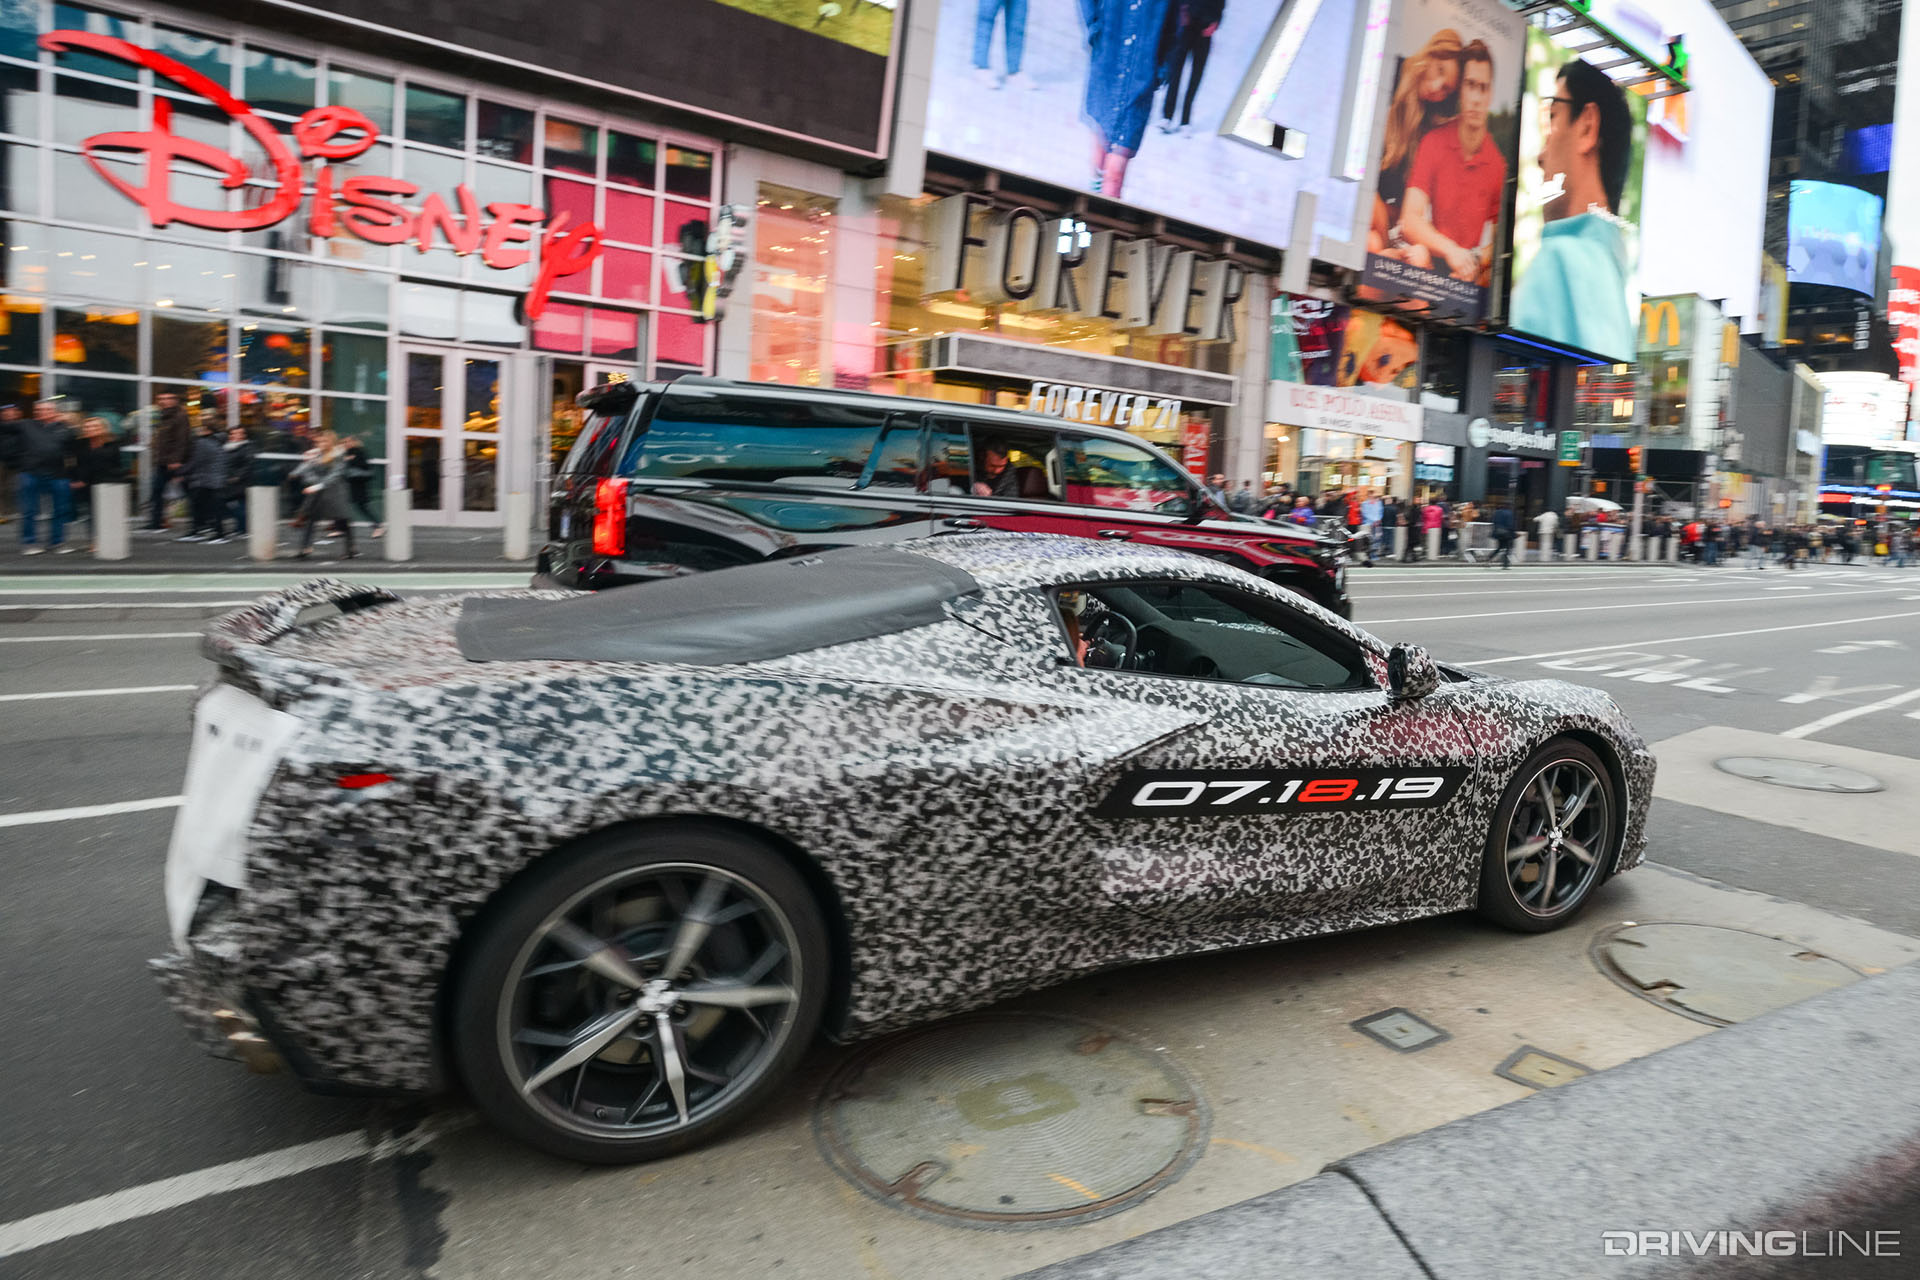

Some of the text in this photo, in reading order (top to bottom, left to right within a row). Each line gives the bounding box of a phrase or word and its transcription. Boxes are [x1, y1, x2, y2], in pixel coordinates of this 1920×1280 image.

[924, 191, 1246, 343] FOREVER
[1029, 381, 1183, 430] FOREVER 21
[1131, 776, 1445, 807] 07.18.19
